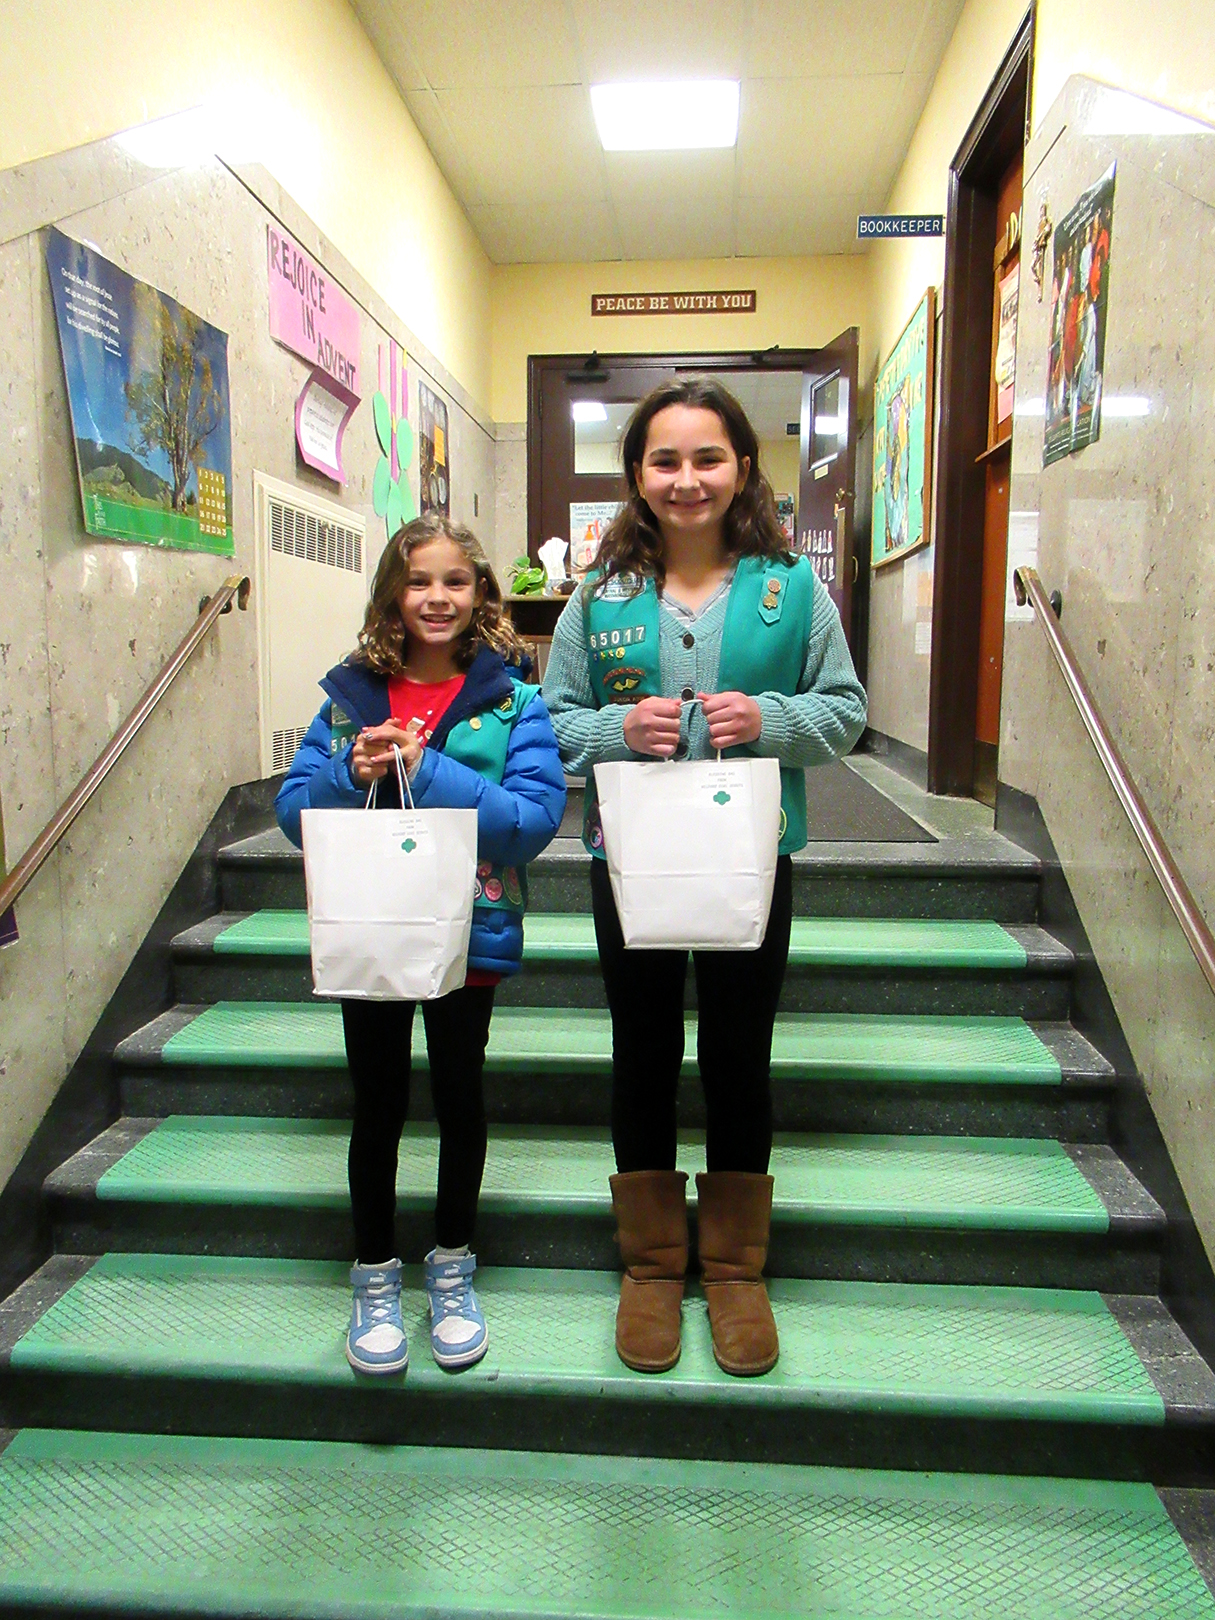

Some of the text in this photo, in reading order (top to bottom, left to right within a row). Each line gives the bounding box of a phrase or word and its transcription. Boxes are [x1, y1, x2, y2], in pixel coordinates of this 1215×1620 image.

[860, 220, 940, 233] BOOKKEEPER
[270, 229, 326, 315] REJOICE
[596, 294, 752, 311] PEACE BE WITH YOU
[302, 300, 315, 344] IN
[317, 332, 356, 391] ADVENT
[590, 626, 645, 648] 65017
